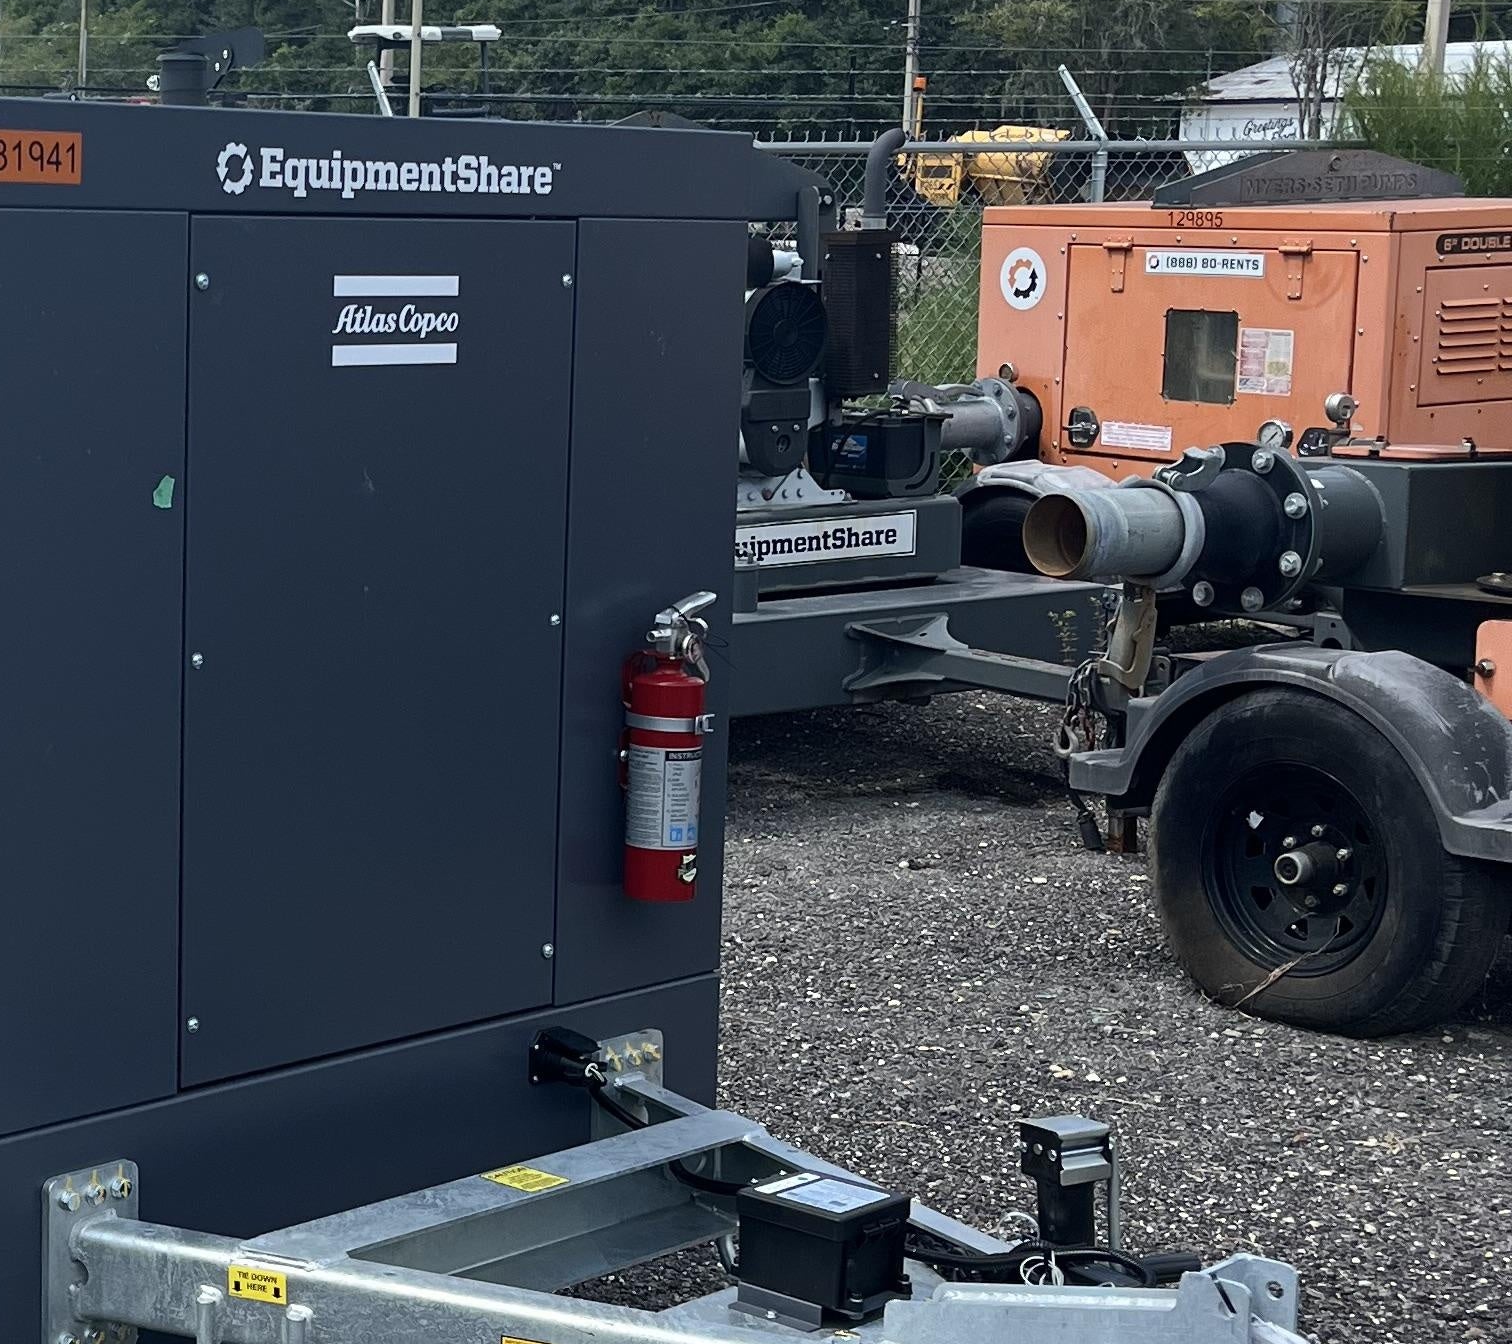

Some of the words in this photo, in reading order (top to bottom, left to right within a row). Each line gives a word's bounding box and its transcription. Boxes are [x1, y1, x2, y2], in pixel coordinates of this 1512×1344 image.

[1168, 211, 1224, 227] 129895
[1461, 236, 1511, 250] DOUBLE
[1166, 256, 1197, 268] (888)
[1201, 258, 1259, 270] 80-RENTS
[332, 304, 397, 335] Atlas
[399, 304, 459, 338] Copco
[735, 527, 897, 561] uipmentShare
[237, 1270, 249, 1279] TIE
[251, 1273, 278, 1285] DOWN
[246, 1282, 268, 1293] HERE
